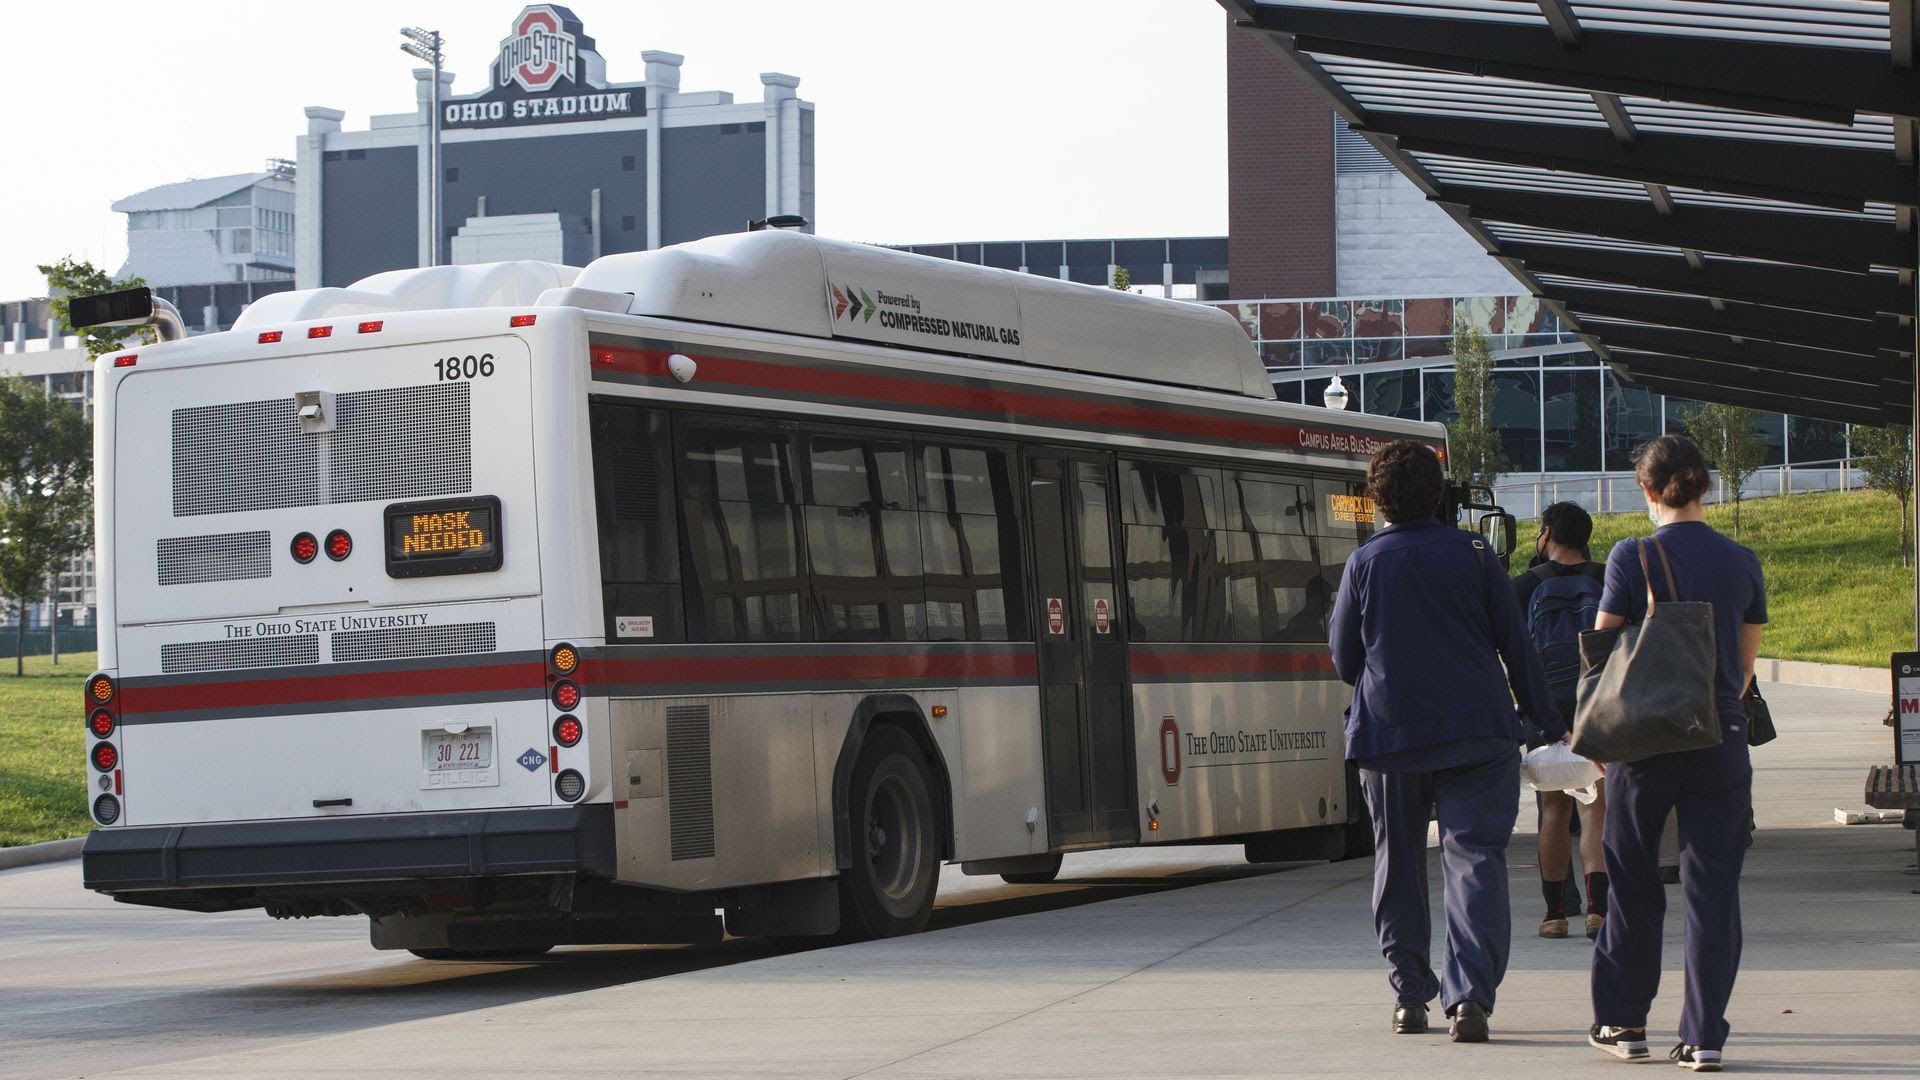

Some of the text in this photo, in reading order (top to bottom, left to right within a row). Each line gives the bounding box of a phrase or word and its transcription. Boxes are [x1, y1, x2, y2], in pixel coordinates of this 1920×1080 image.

[446, 93, 631, 122] OHIO STADIUM
[877, 290, 921, 313] Powered by
[879, 310, 1020, 346] COMPRESSED NATURAL GAS
[434, 353, 494, 381] 1806
[413, 511, 470, 533] MASK
[404, 529, 483, 553] NEEDED
[224, 613, 429, 638] THE OHIO STATE UNIVERSITY
[437, 742, 480, 761] 30 221
[1186, 729, 1326, 755] THE OHIO STATE UNIVERSITY
[522, 756, 542, 765] CNG
